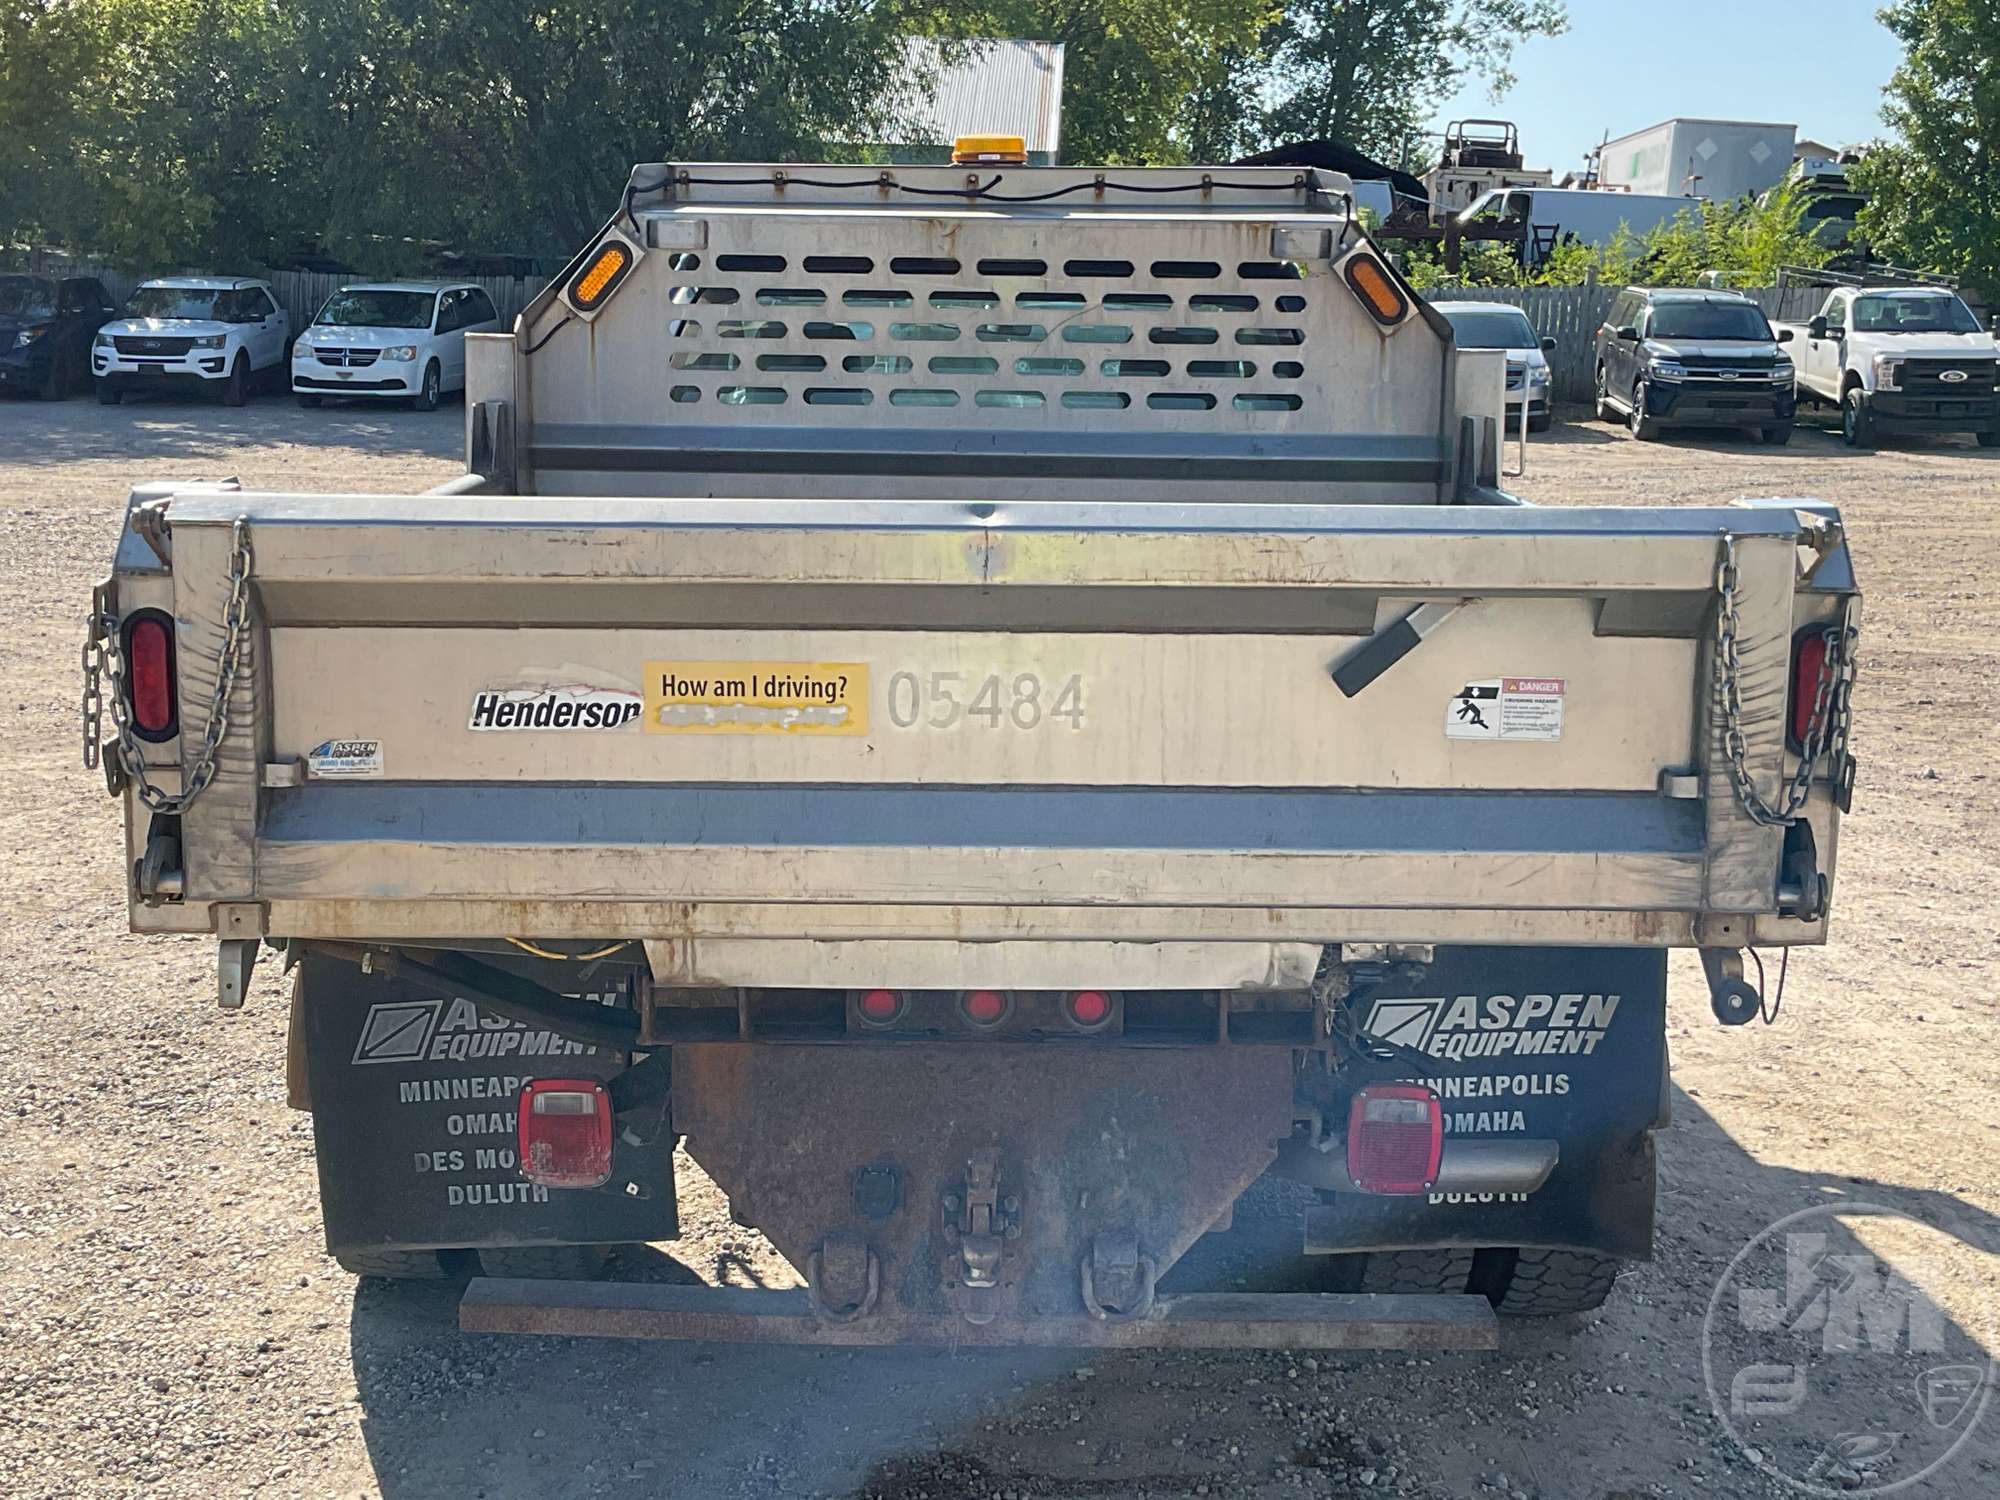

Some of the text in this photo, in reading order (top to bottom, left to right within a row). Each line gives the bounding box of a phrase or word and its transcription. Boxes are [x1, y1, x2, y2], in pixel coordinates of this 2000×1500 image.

[662, 674, 848, 704] How am I driving?
[1519, 681, 1559, 692] DANGER
[472, 694, 642, 728] Henderson
[887, 671, 1086, 731] 05484
[335, 742, 377, 752] ASPEN
[1438, 994, 1621, 1031] ASPEN
[1429, 1030, 1606, 1062] EQUIPMENT
[1396, 1073, 1571, 1099] NNEAPOLIS
[447, 1112, 518, 1136] OMAH
[414, 1150, 465, 1173] DES
[447, 1182, 551, 1206] DULUTH
